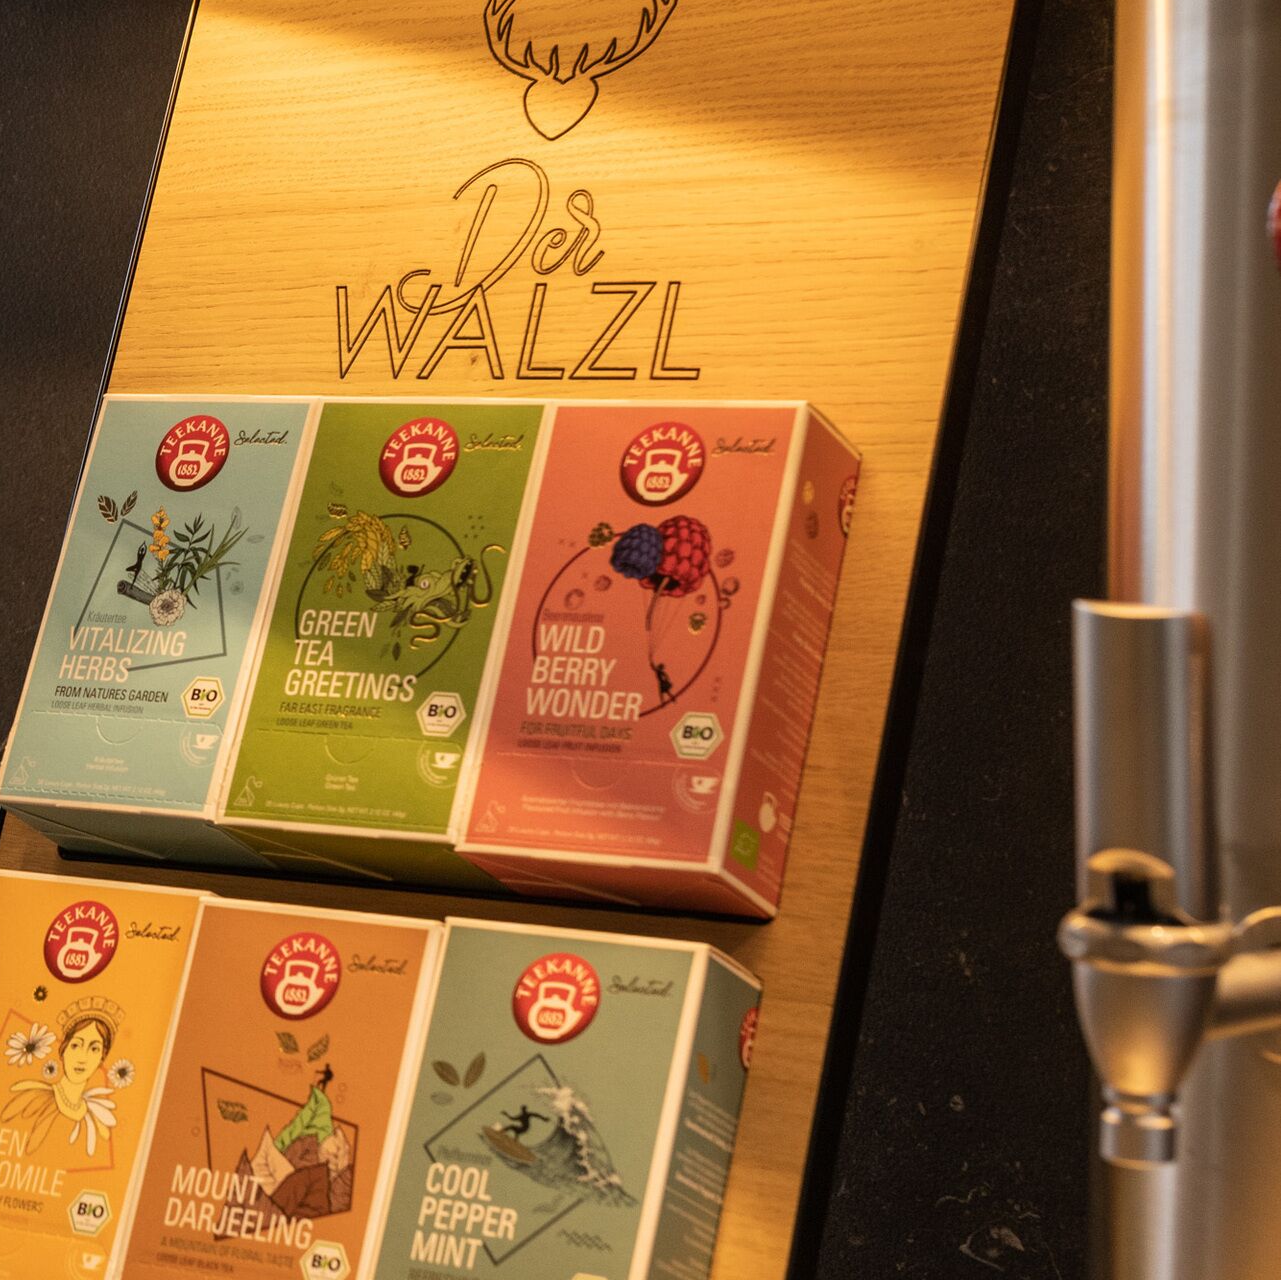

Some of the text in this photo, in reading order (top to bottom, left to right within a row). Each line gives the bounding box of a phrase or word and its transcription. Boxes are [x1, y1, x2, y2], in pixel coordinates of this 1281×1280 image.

[398, 158, 605, 315] Der
[335, 280, 701, 380] WALZL
[159, 419, 226, 458] TEEKANNE
[383, 421, 456, 461] TEEKANNE
[623, 426, 703, 469] TEEKANNE
[176, 463, 199, 478] 1882
[402, 467, 426, 482] 1882
[299, 608, 379, 638] GREEN
[539, 623, 605, 654] WILD
[69, 625, 188, 657] VITALIZING
[294, 638, 334, 667] TEA
[58, 654, 132, 683] HERBS
[284, 668, 418, 703] GREETINGS
[531, 655, 617, 686] BERRY
[54, 685, 169, 703] FROM NATURES GARDEN
[279, 701, 383, 719] FAR EAST FRAGRANCE
[526, 687, 643, 721] WONDER
[48, 907, 116, 950] TEEKANNE
[65, 952, 87, 968] 1882
[263, 936, 340, 985] TEEKANNE
[283, 987, 308, 1003] 1882
[515, 958, 598, 1007] TEEKANNE
[170, 1163, 264, 1206] MOUNT
[425, 1161, 493, 1202] COOL
[3, 1195, 45, 1214] FLOWERS
[417, 1195, 519, 1241] PEPPER
[163, 1196, 314, 1250] DARJEELING
[409, 1229, 484, 1270] MINT
